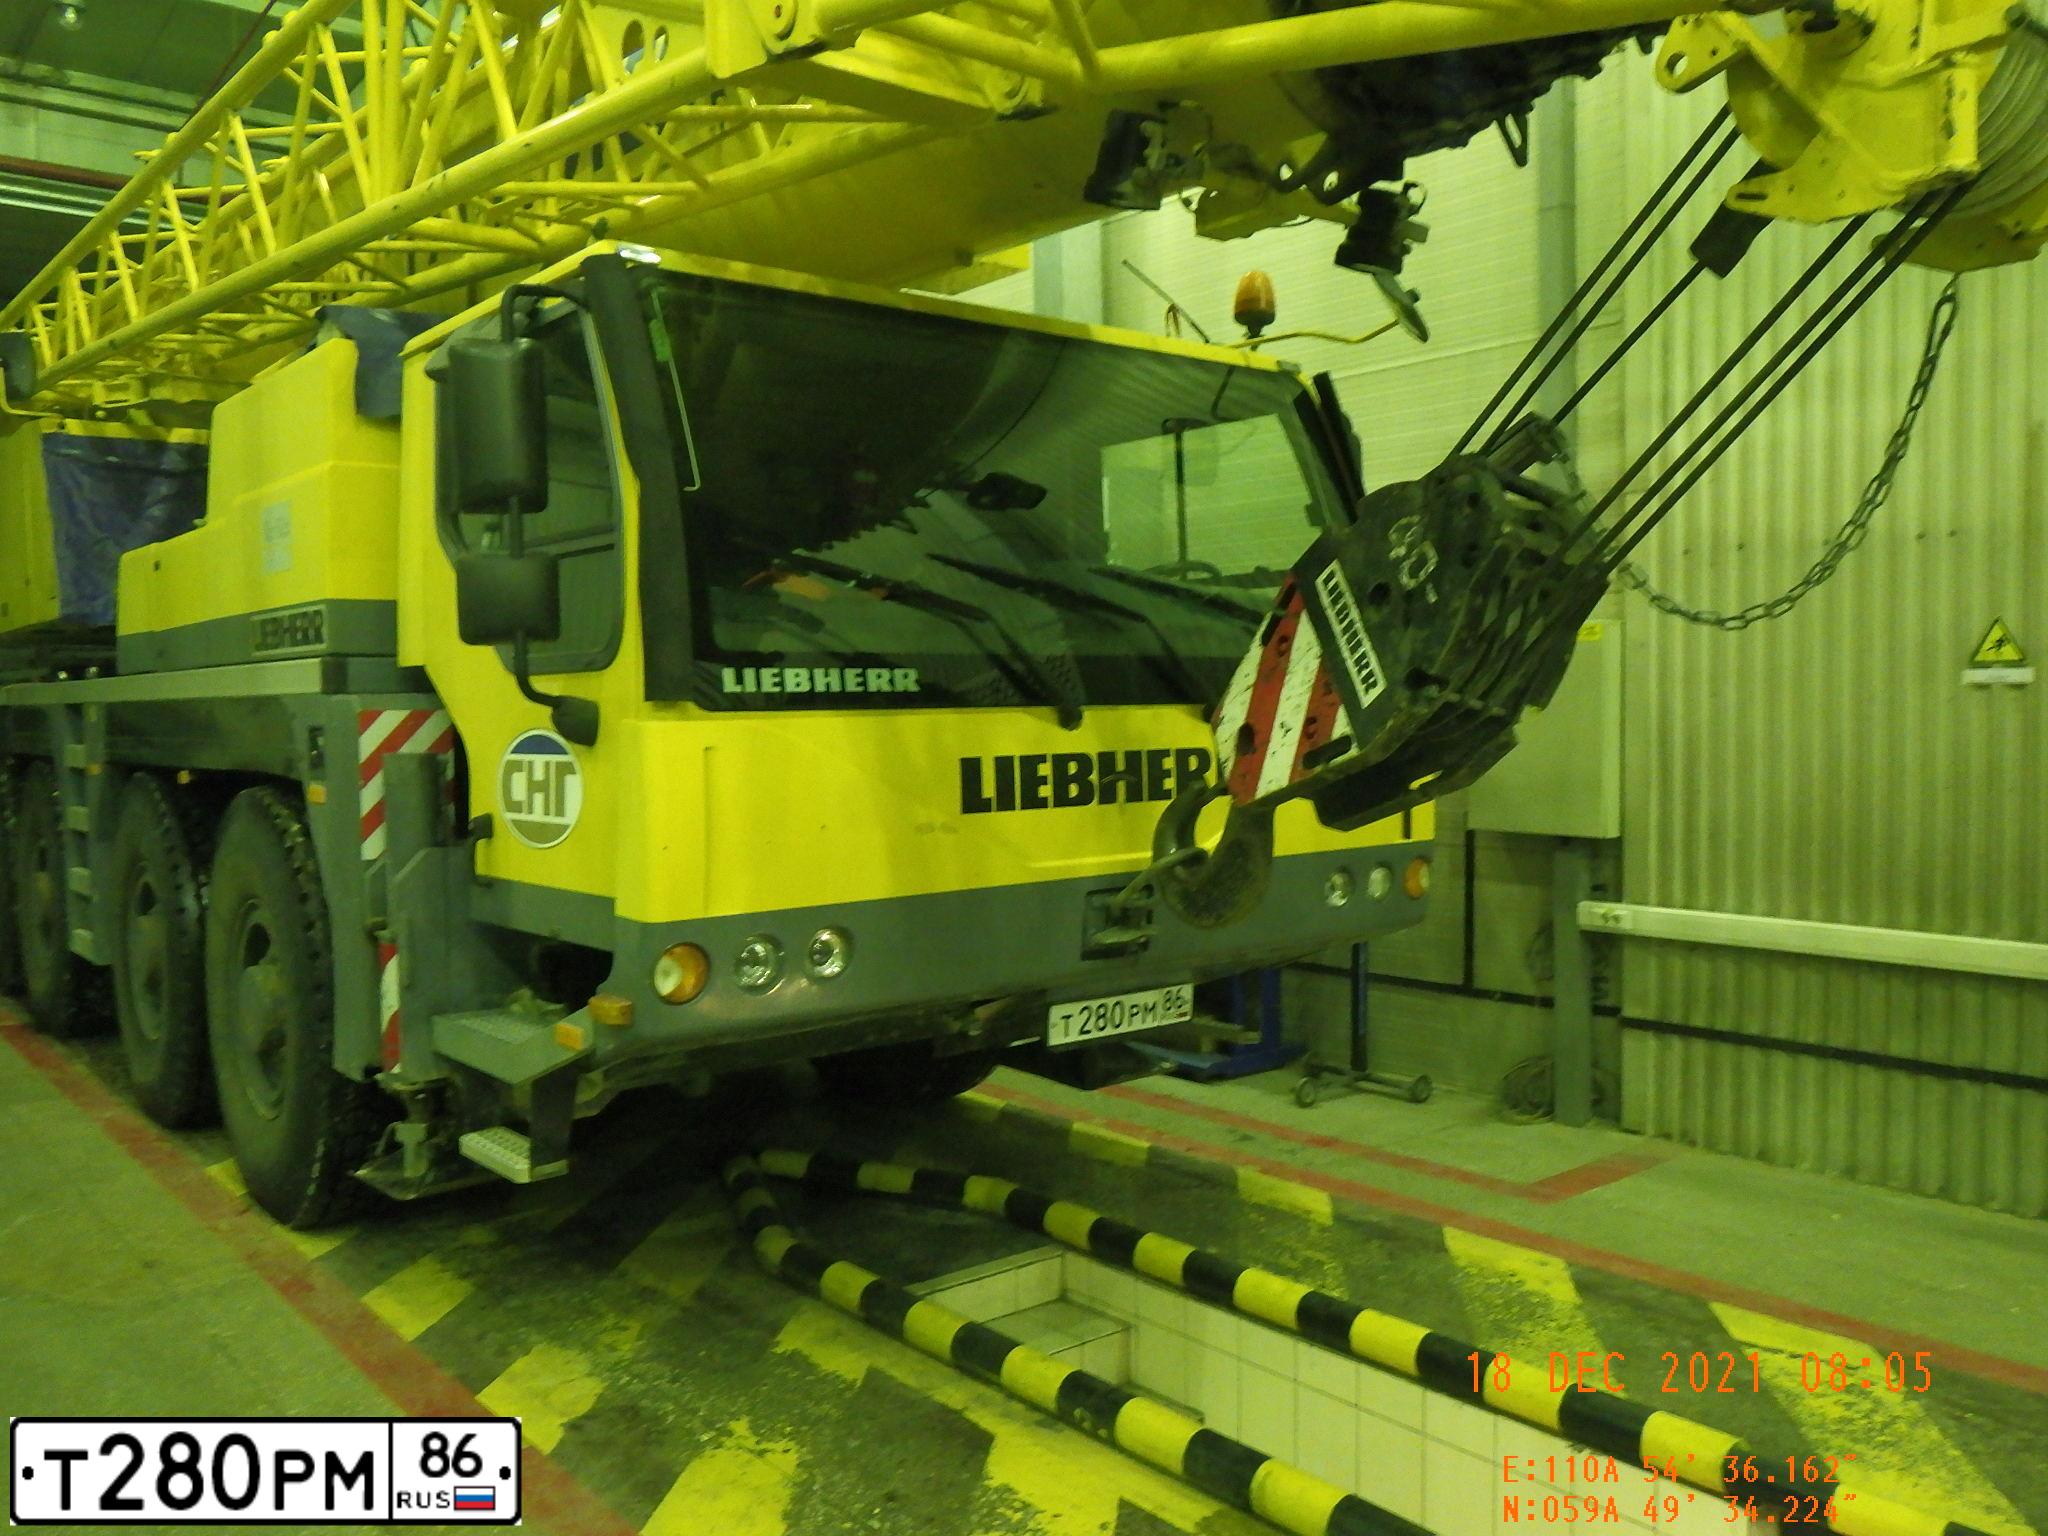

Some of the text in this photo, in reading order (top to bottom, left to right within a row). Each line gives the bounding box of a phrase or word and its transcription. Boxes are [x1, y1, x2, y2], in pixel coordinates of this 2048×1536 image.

[1322, 568, 1378, 695] LIEBHERR
[721, 667, 920, 693] LIEBHERR
[959, 747, 1225, 815] LIEBHER
[1162, 986, 1186, 1012] 86
